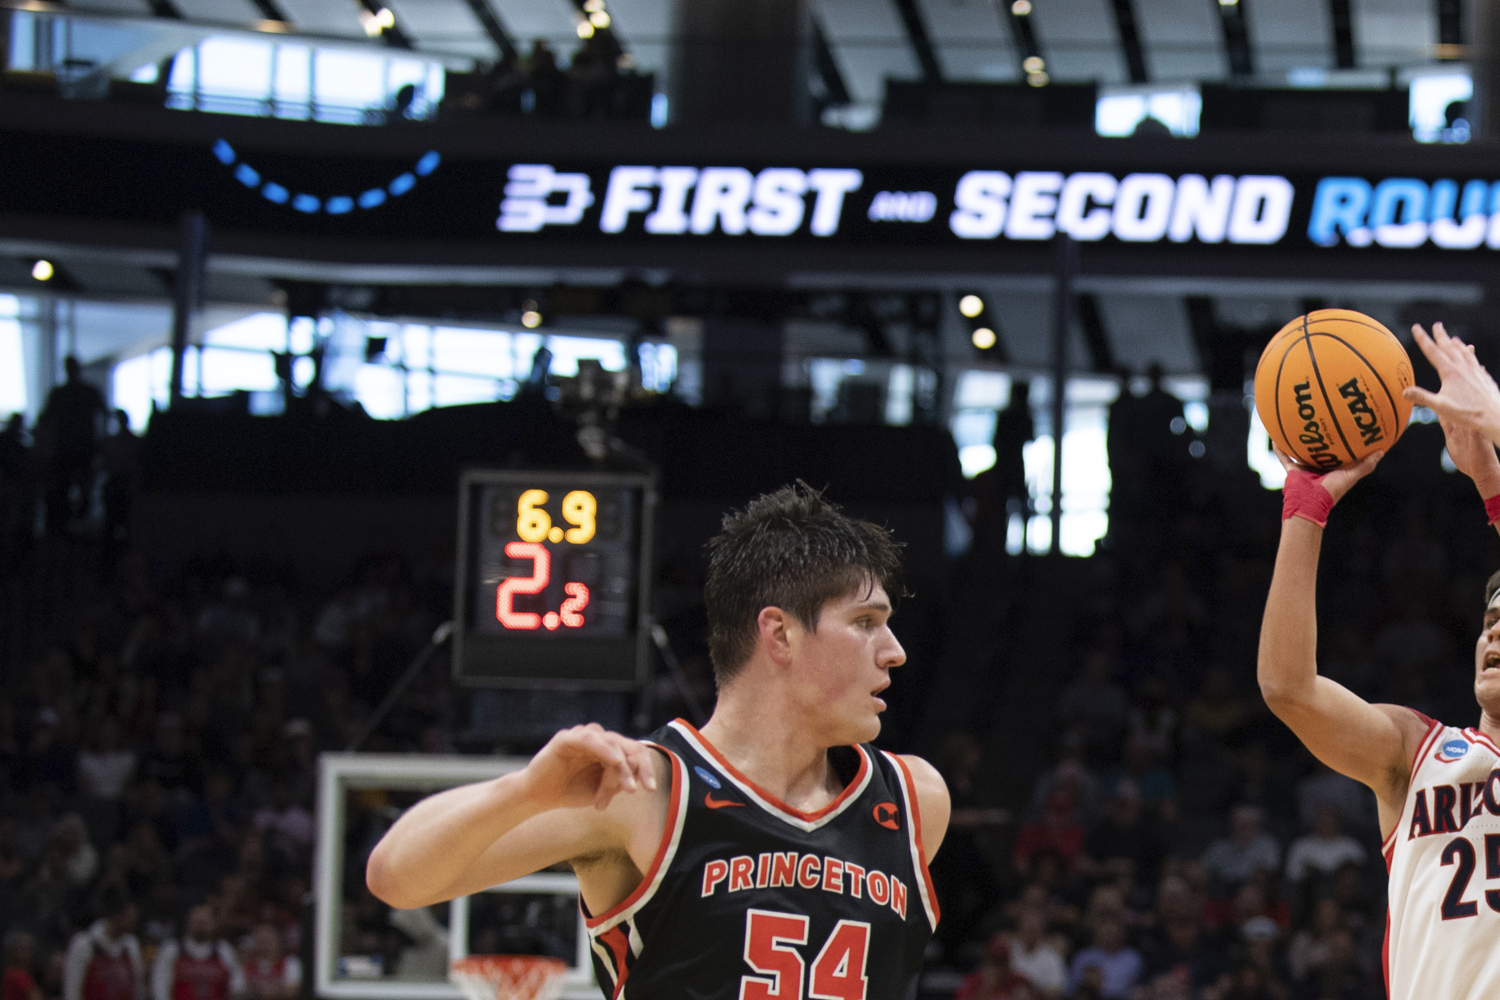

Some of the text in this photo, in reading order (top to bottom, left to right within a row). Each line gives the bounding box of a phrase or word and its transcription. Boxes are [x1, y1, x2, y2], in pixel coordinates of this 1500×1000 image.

[600, 165, 863, 236] FIRST
[867, 190, 938, 223] AND
[949, 170, 1294, 244] SECOND
[1293, 380, 1343, 471] Wilson
[1338, 377, 1384, 447] NCAA
[516, 489, 597, 544] 6.9
[496, 541, 590, 630] 2.2
[701, 852, 907, 921] PRINCETON
